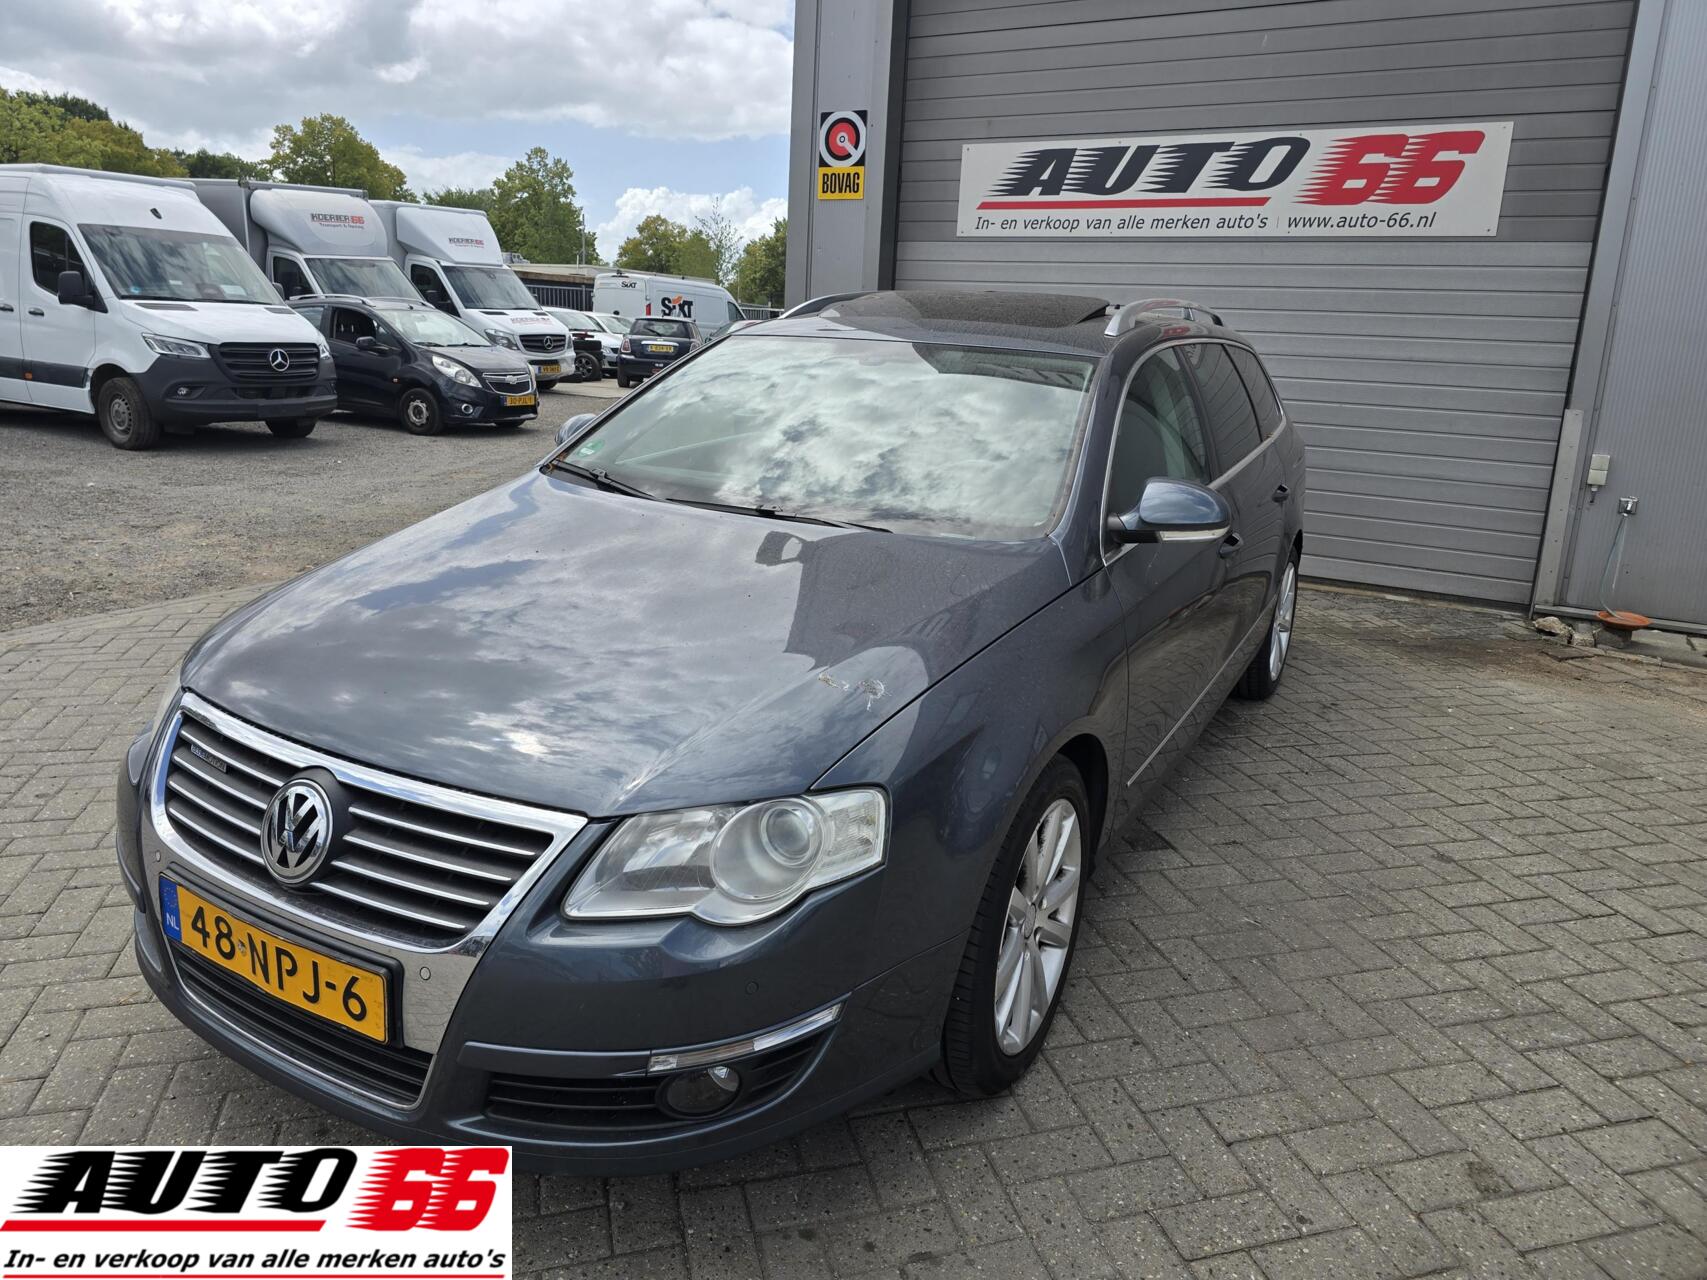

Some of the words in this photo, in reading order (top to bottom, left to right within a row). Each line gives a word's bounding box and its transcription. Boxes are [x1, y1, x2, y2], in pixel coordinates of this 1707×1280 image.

[983, 137, 1311, 197] AUTO
[1293, 130, 1485, 206] 66
[821, 172, 860, 194] BOVAG
[975, 216, 995, 230] In-
[1000, 219, 1017, 230] en
[1023, 215, 1079, 233] verkoop
[1086, 218, 1112, 230] van
[1117, 215, 1144, 230] alle
[1150, 215, 1210, 230] merken
[1216, 213, 1268, 229] auto's
[1287, 211, 1437, 229] www.auto-66.nl
[166, 913, 180, 931] NL
[191, 905, 368, 1022] 48-NPJ-6
